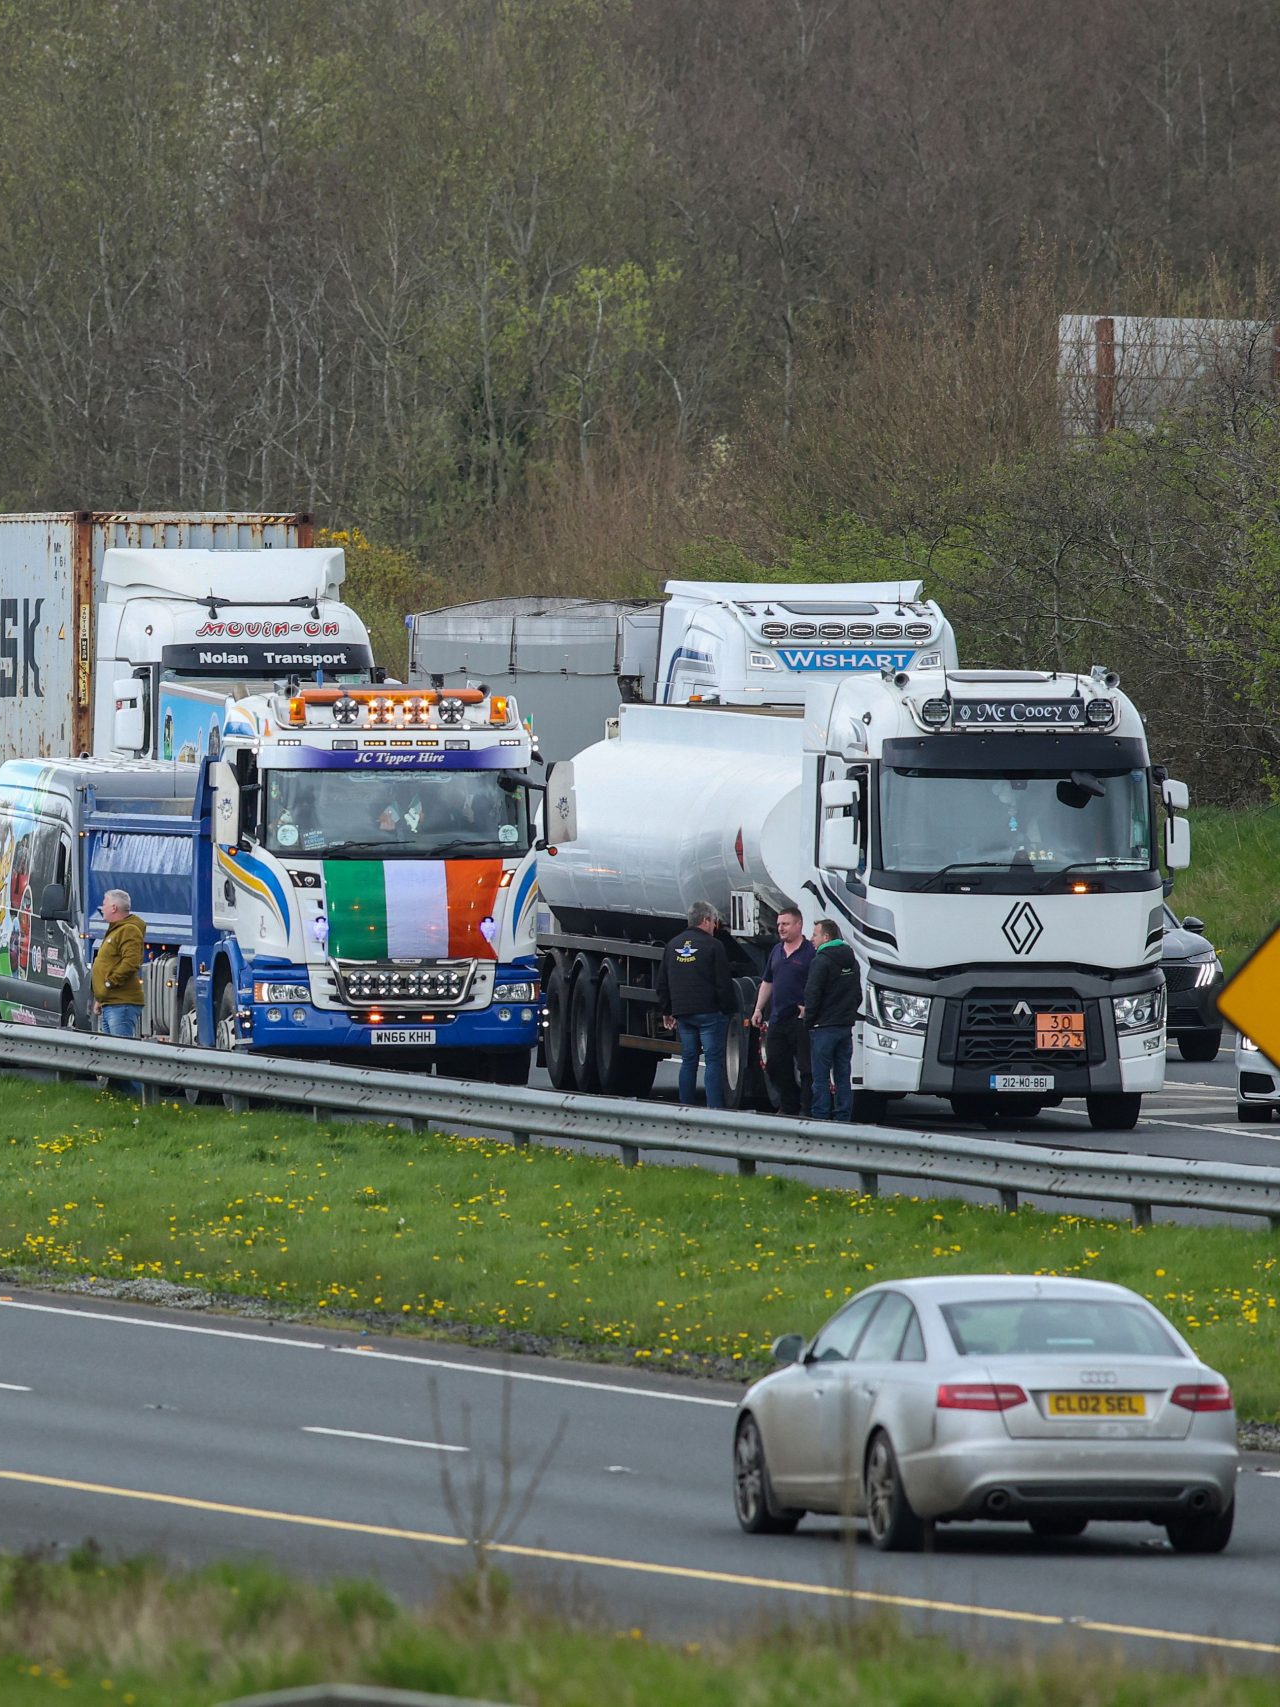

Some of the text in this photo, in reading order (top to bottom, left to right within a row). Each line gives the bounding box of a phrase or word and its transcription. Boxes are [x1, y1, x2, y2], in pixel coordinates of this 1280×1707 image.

[199, 652, 347, 667] Nolan Transport
[977, 703, 1063, 721] Mc Cooey
[354, 752, 445, 765] JC Tipper Hire
[1051, 1015, 1071, 1030] 30
[376, 1032, 431, 1042] WN66 KHH
[1041, 1034, 1083, 1047] 1223
[1002, 1078, 1048, 1088] 212-MO-861
[1055, 1396, 1138, 1413] CL02 SEL
